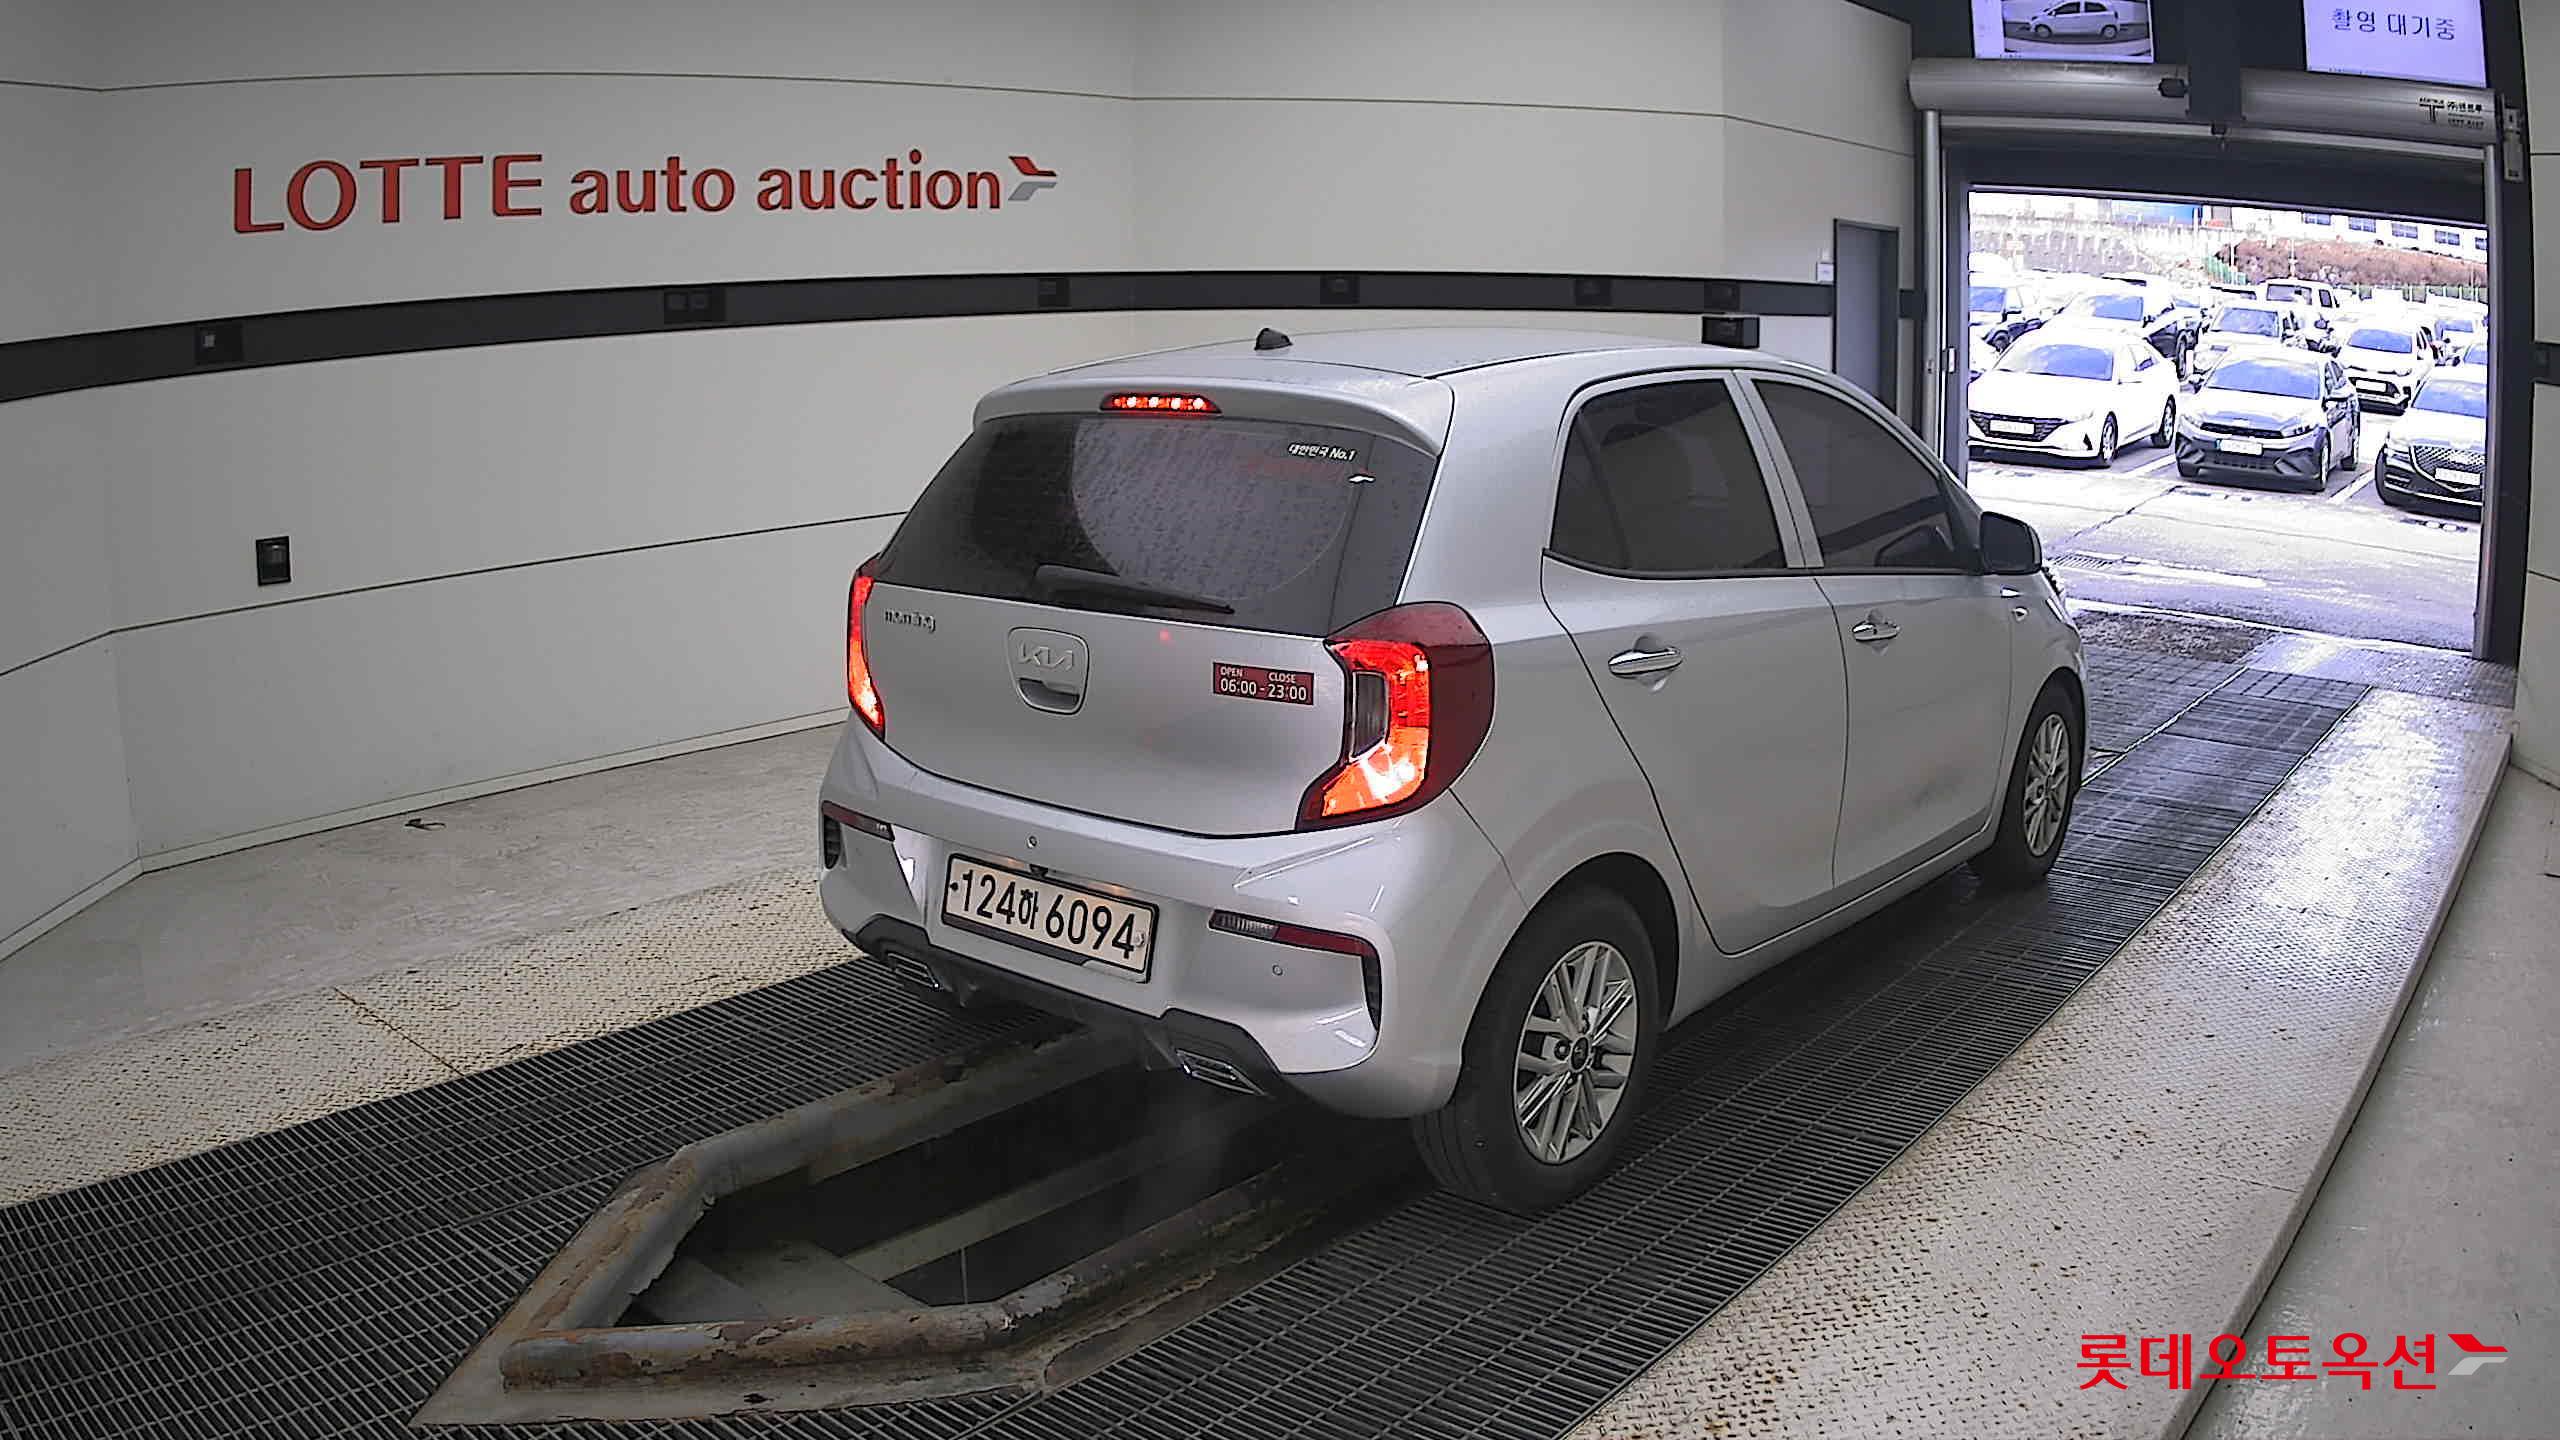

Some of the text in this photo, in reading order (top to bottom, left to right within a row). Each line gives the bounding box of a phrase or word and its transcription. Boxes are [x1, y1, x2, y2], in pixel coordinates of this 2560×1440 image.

[2332, 8, 2376, 33] 촬영
[233, 148, 1001, 235] LOTTE auto auction
[1288, 443, 1357, 461] 대한민국 No.1
[1018, 641, 1074, 672] KIA
[1220, 666, 1297, 684] OPEN CLOSE
[1220, 677, 1257, 696] 06:00
[1267, 683, 1307, 701] 23:00
[962, 868, 1136, 960] 124하 6094
